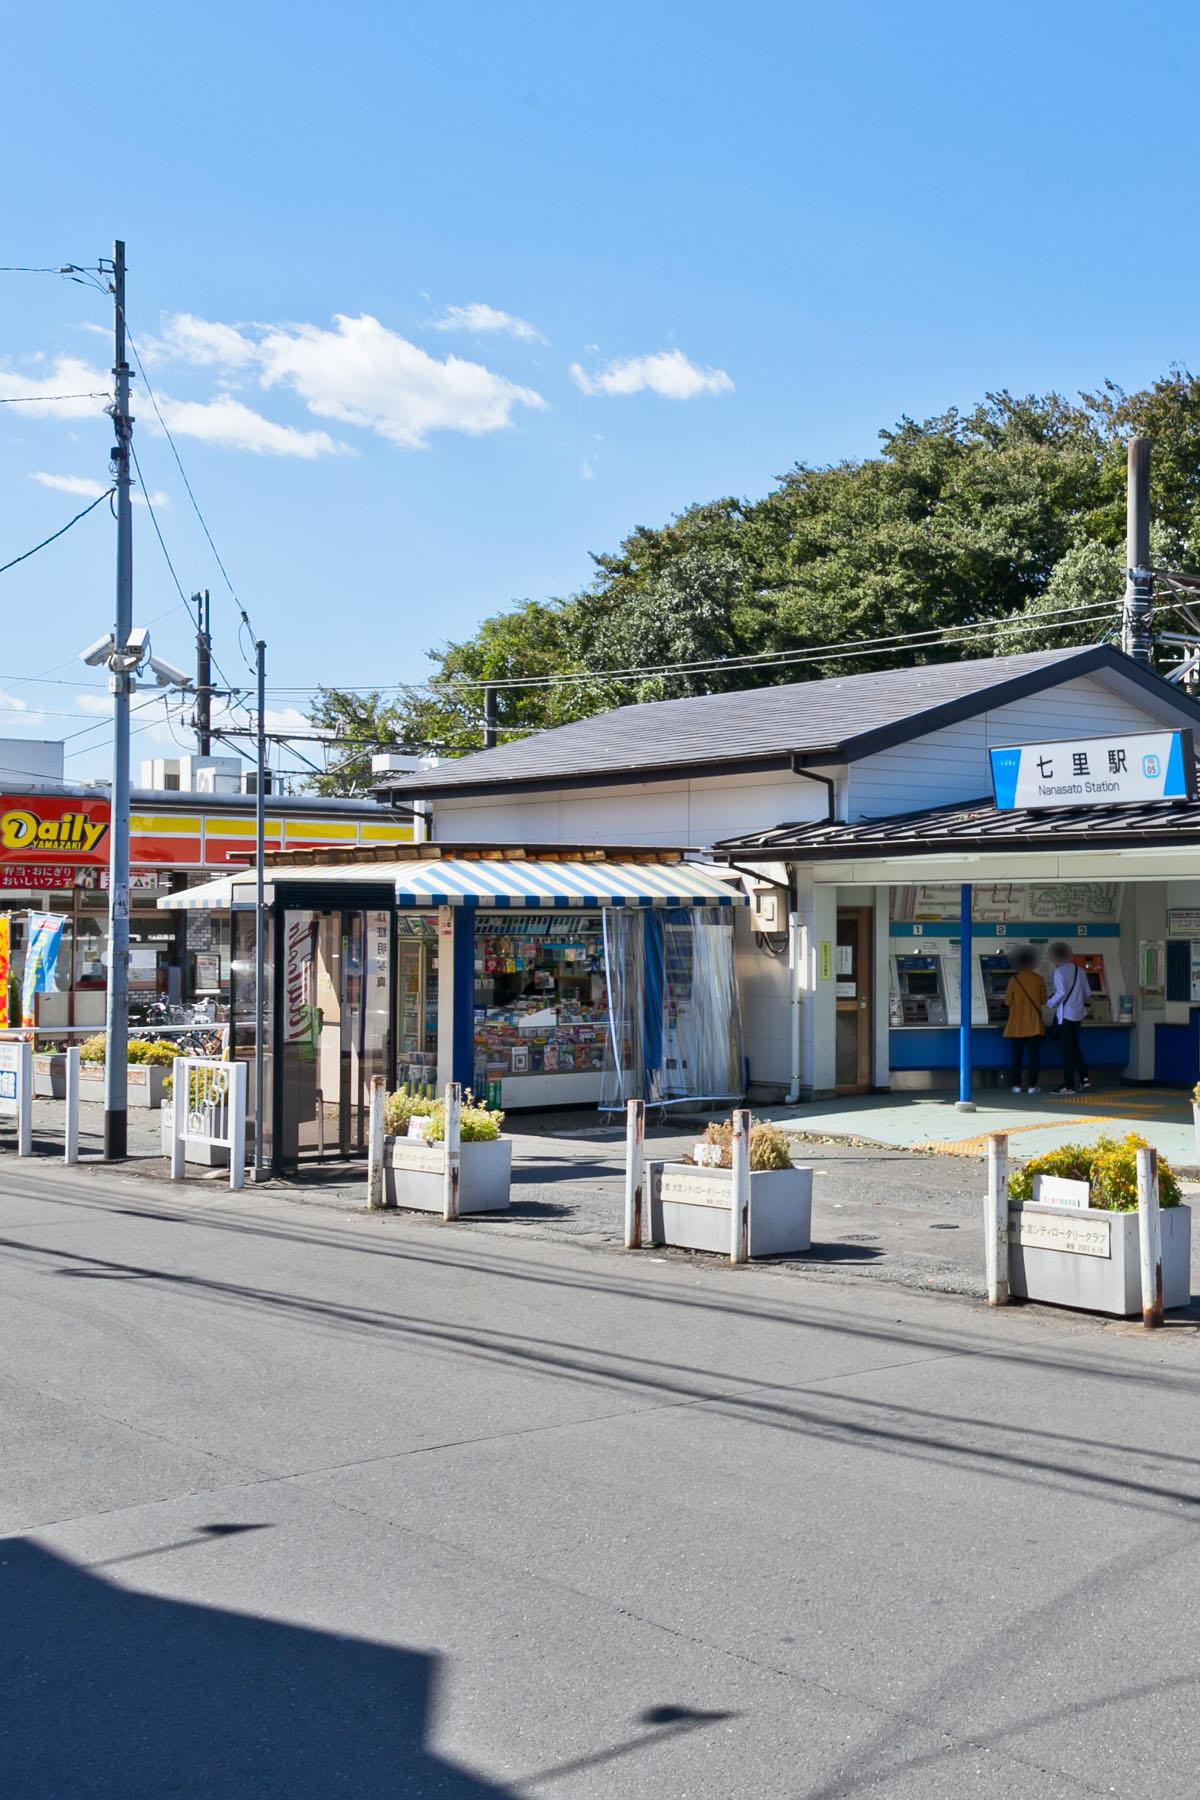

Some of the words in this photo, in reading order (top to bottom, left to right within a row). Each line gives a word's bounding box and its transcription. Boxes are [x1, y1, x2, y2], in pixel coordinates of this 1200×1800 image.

[1036, 749, 1127, 779] 七里駅
[1147, 766, 1156, 774] 05
[1039, 783, 1082, 796] Nanasato
[1085, 781, 1120, 793] Station
[2, 811, 107, 851] Daily
[33, 840, 81, 850] YAMAZAKI
